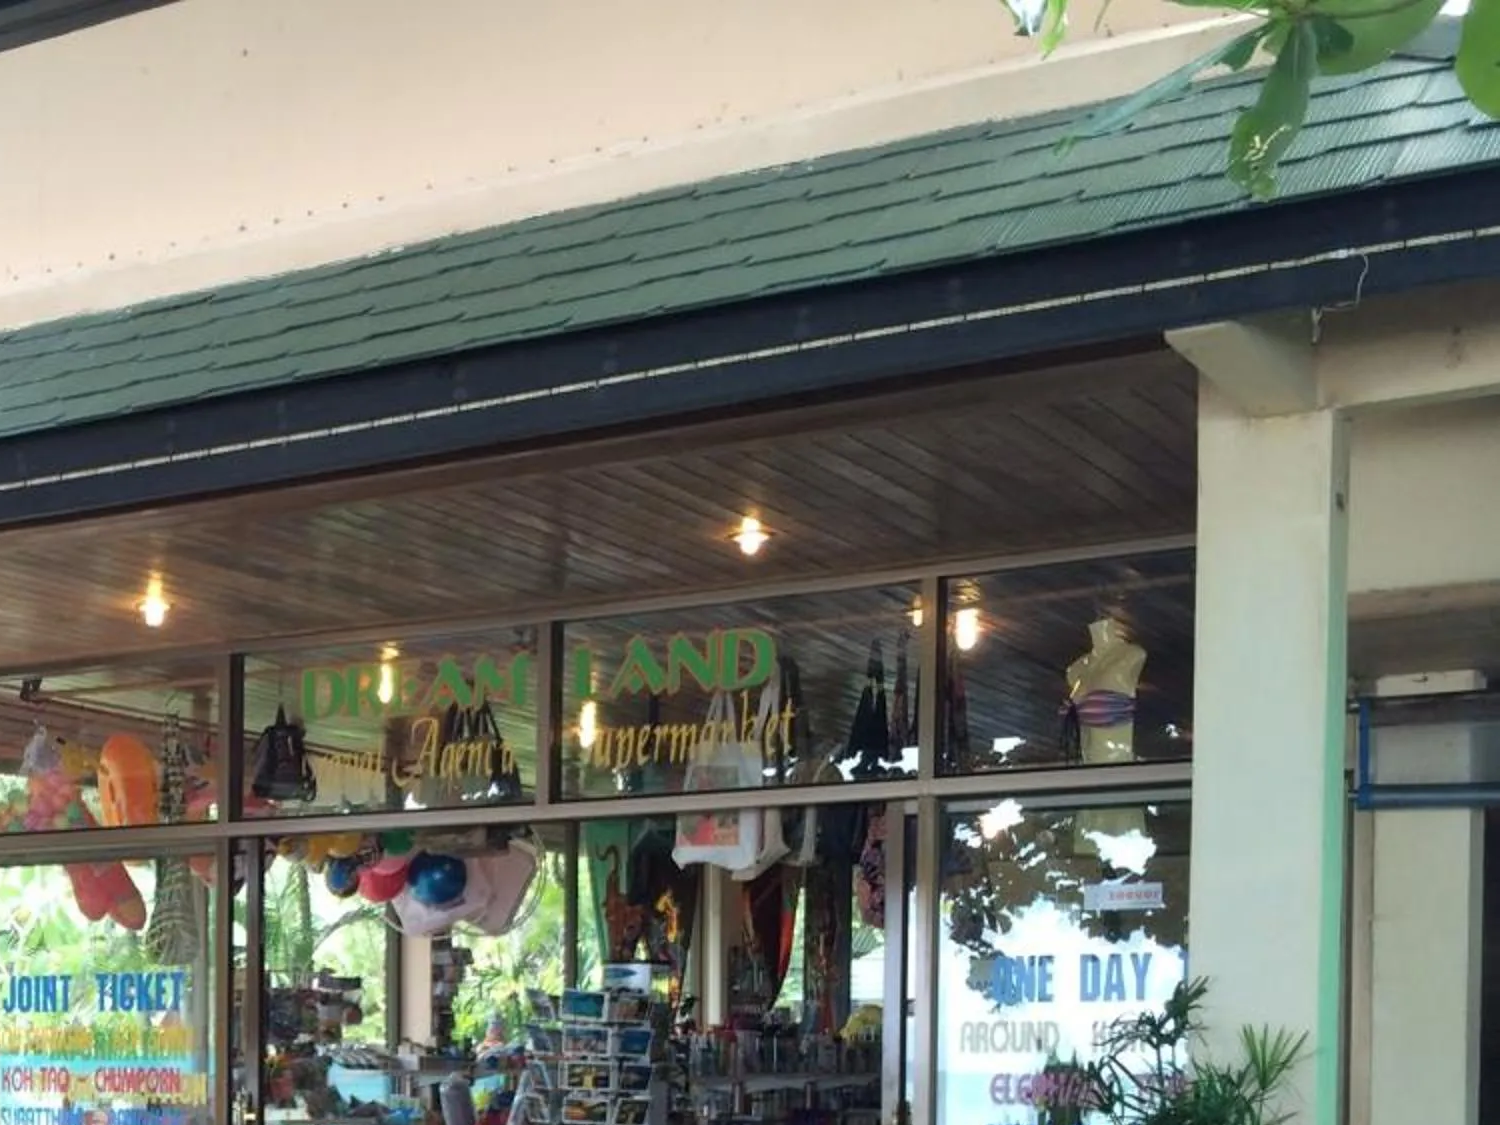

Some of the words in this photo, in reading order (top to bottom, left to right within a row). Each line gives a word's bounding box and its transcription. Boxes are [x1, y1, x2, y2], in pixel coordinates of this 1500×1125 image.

[2, 974, 72, 1013] JOINT
[95, 970, 185, 1012] TICKET
[991, 955, 1055, 1002] ONE
[1080, 953, 1153, 1002] DAY
[960, 1020, 1060, 1054] AROUND
[2, 1066, 33, 1093] KOH
